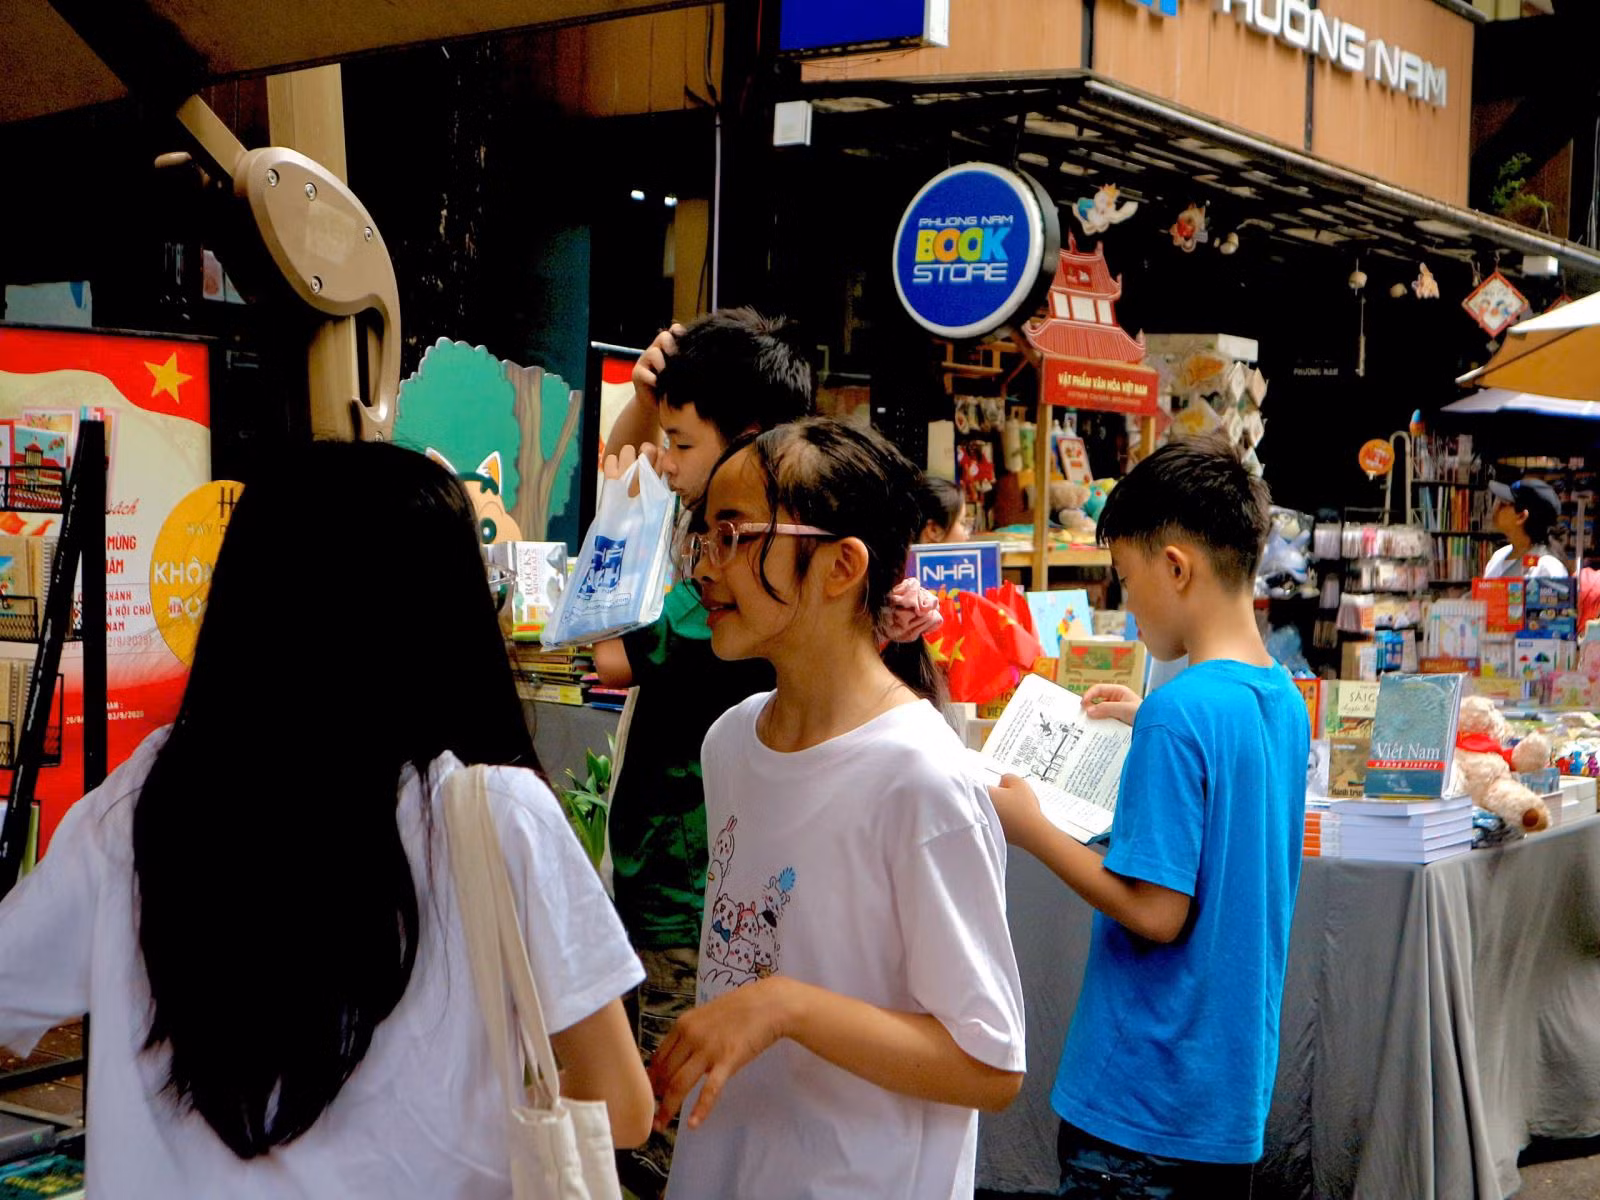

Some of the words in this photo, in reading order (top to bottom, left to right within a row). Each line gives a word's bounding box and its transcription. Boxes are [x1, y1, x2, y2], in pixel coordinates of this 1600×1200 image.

[1370, 38, 1447, 107] NAM
[981, 215, 1014, 225] NAM
[915, 227, 1010, 263] BOOK
[912, 263, 1008, 283] STORE
[922, 558, 976, 581] NHÀ
[1407, 742, 1441, 759] Nam
